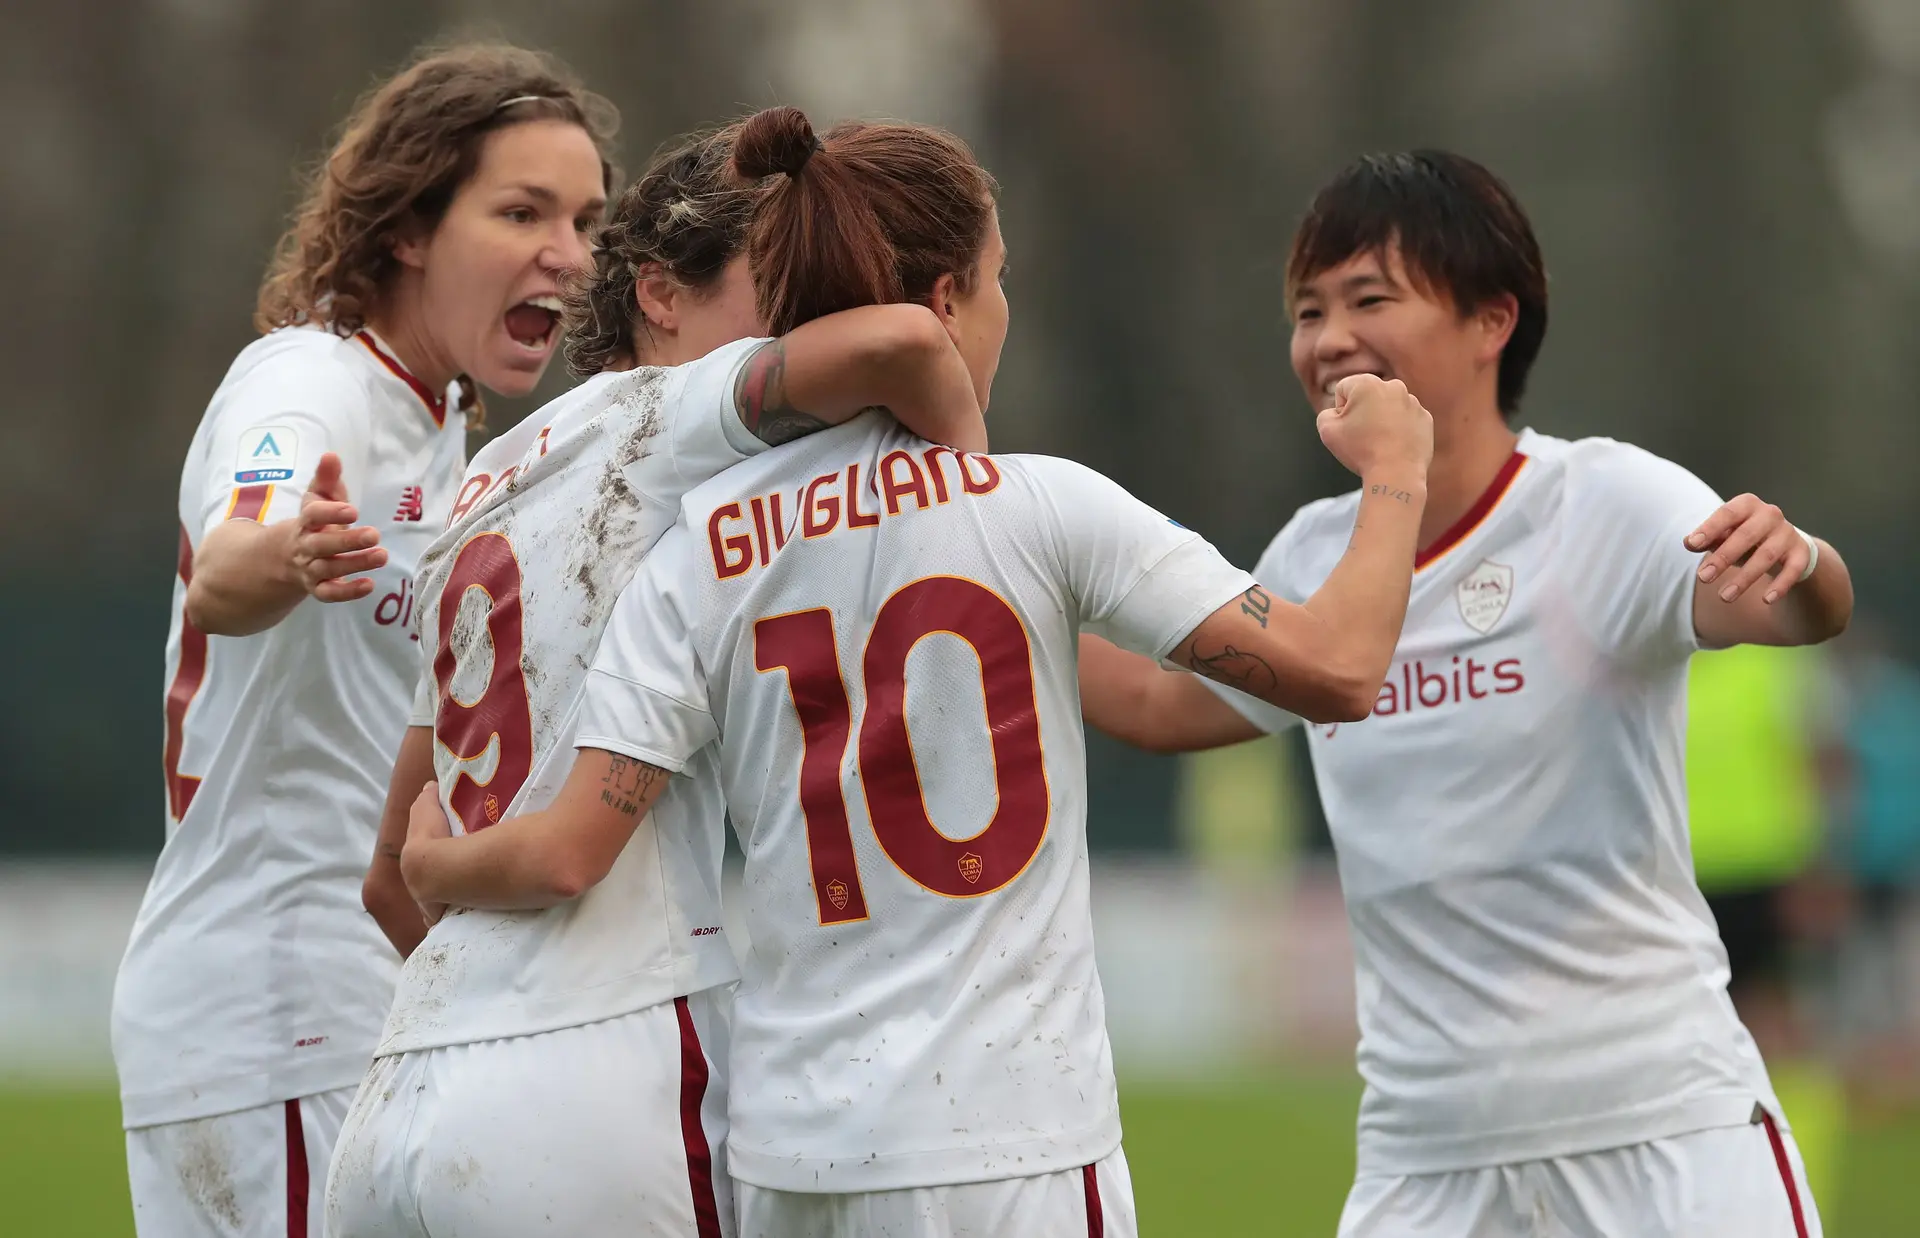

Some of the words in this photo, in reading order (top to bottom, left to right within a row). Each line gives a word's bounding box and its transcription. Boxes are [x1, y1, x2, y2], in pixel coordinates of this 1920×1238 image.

[258, 471, 286, 479] TIM
[433, 531, 533, 835] 9
[1241, 586, 1270, 629] 10
[754, 575, 1050, 925] 10
